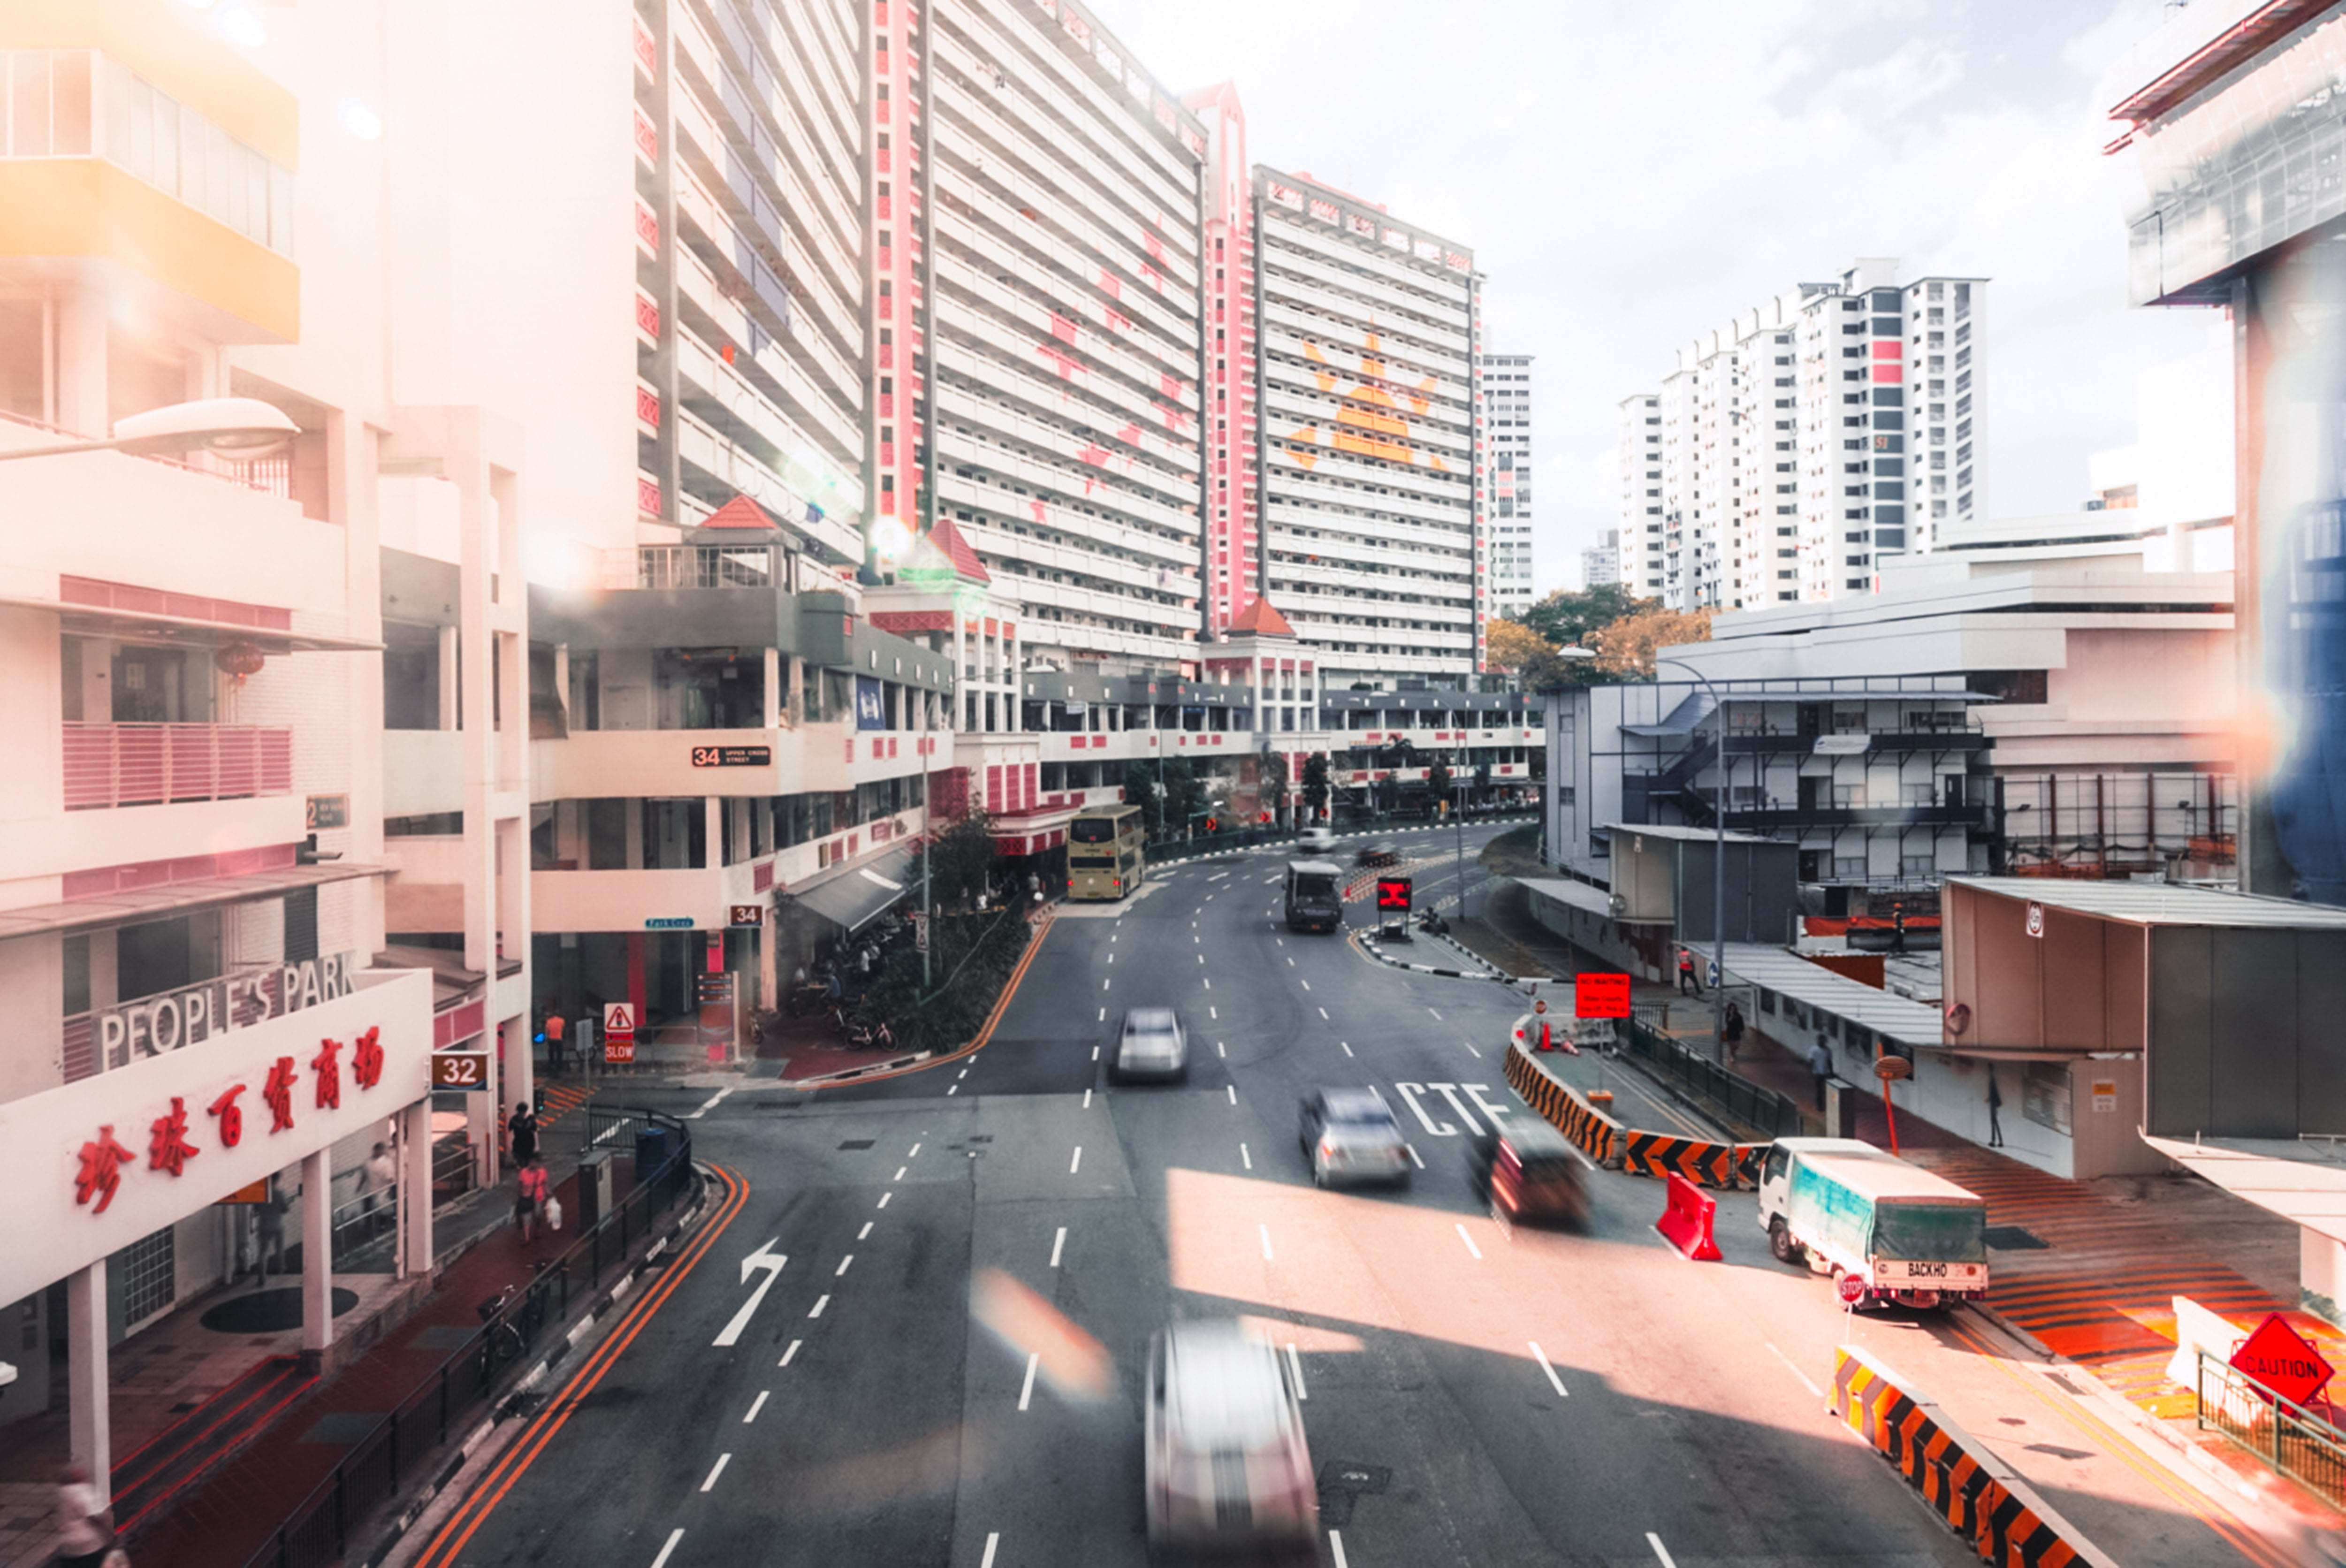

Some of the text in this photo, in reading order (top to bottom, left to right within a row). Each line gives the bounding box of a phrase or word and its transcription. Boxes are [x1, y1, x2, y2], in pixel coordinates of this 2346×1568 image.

[694, 748, 720, 765] 34
[737, 907, 756, 922] 34
[101, 951, 356, 1073] PEOPLE'S PARK
[606, 1046, 633, 1058] SLOW
[443, 1058, 477, 1083] 32
[1908, 1263, 1947, 1277] BACKHO
[1841, 1281, 1864, 1295] STOP
[2245, 1355, 2319, 1379] CAUTION
